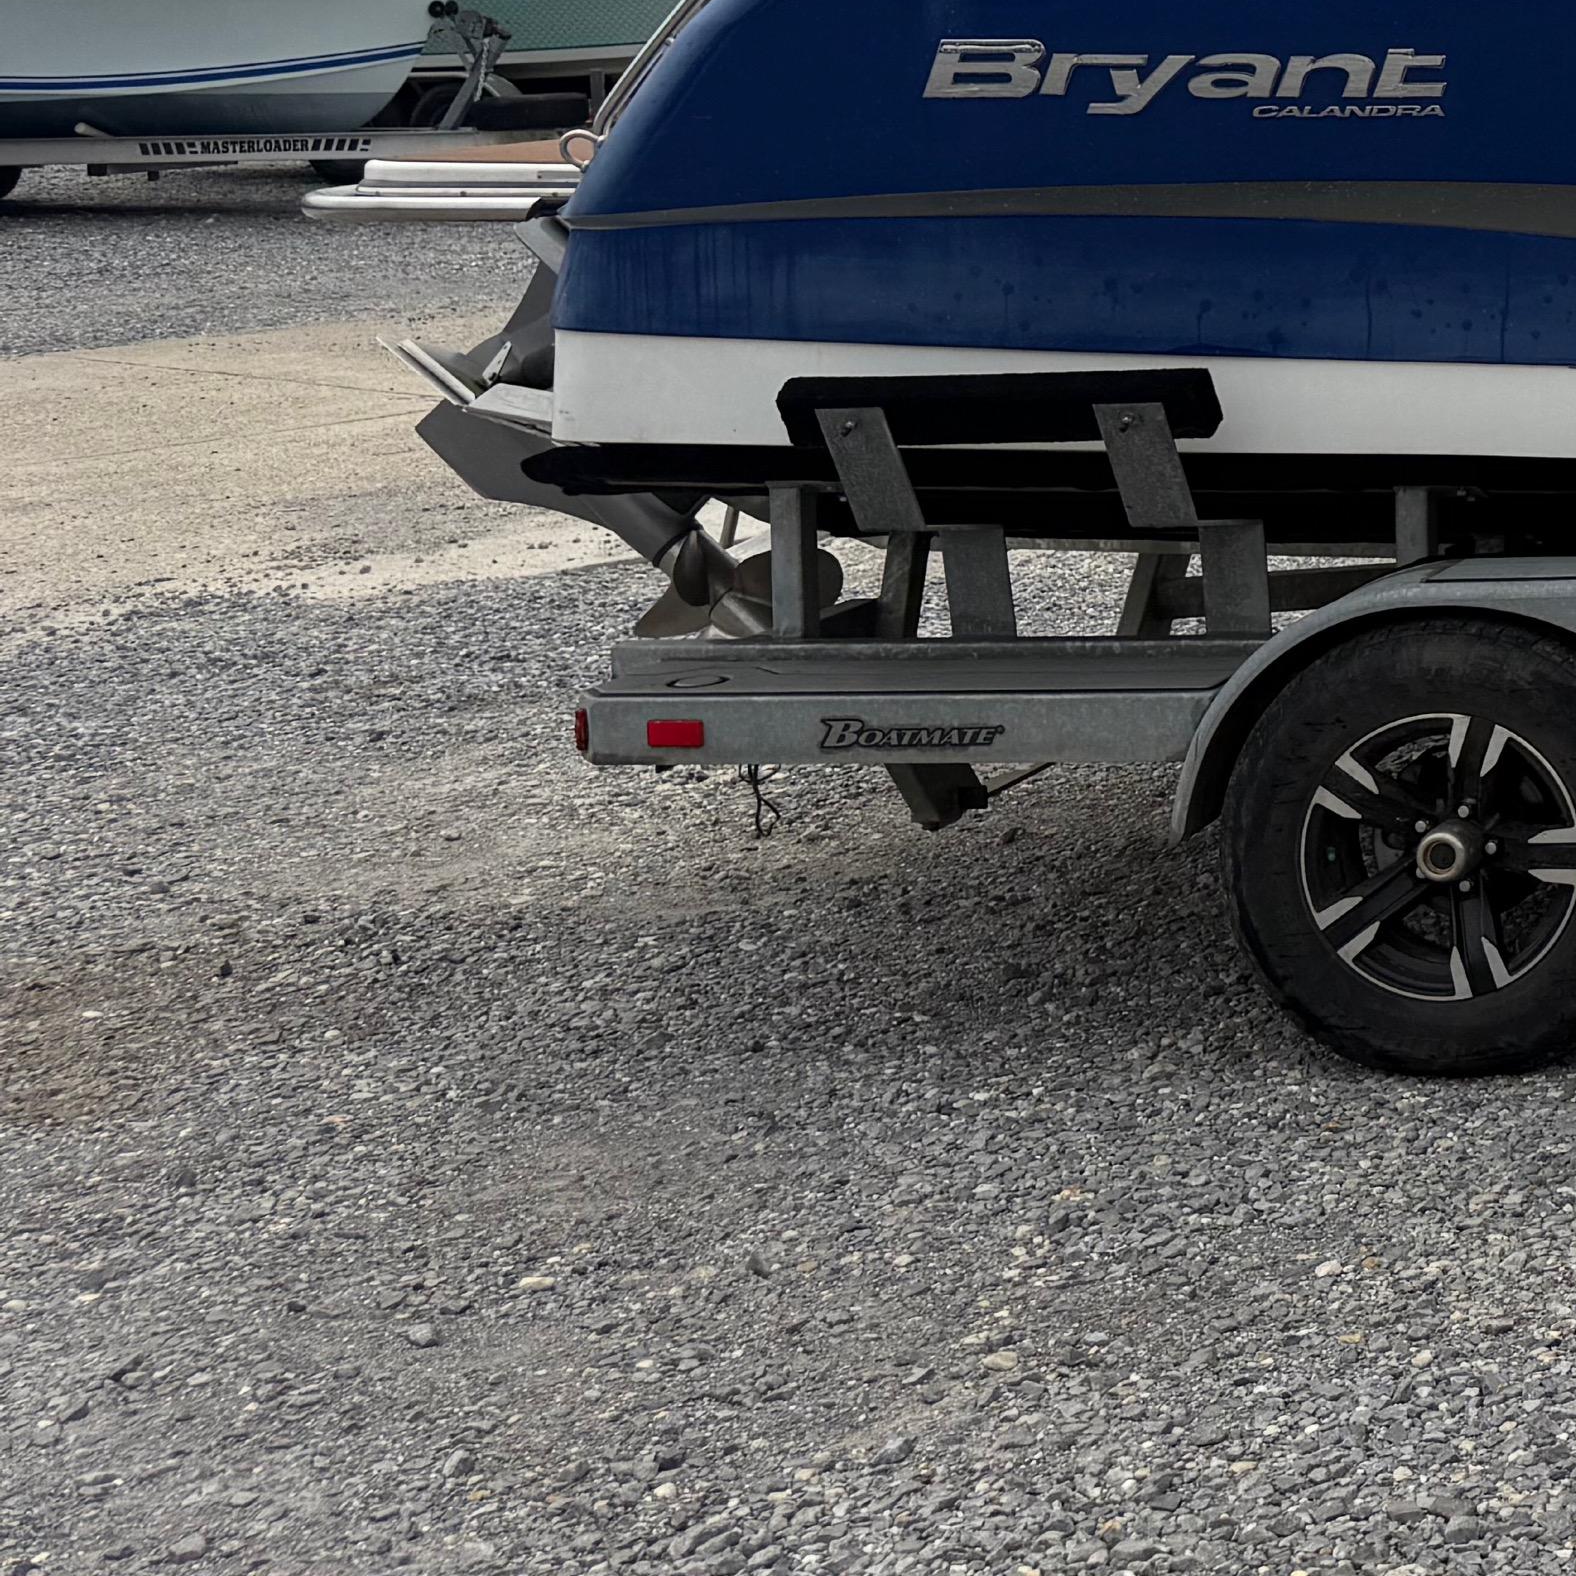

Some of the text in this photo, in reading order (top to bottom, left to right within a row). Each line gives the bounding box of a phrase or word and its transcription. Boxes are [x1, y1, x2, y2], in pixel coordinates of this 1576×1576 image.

[922, 38, 1448, 115] Bryant
[1252, 104, 1446, 118] CALANDRA
[200, 138, 310, 155] MASTERLOADER
